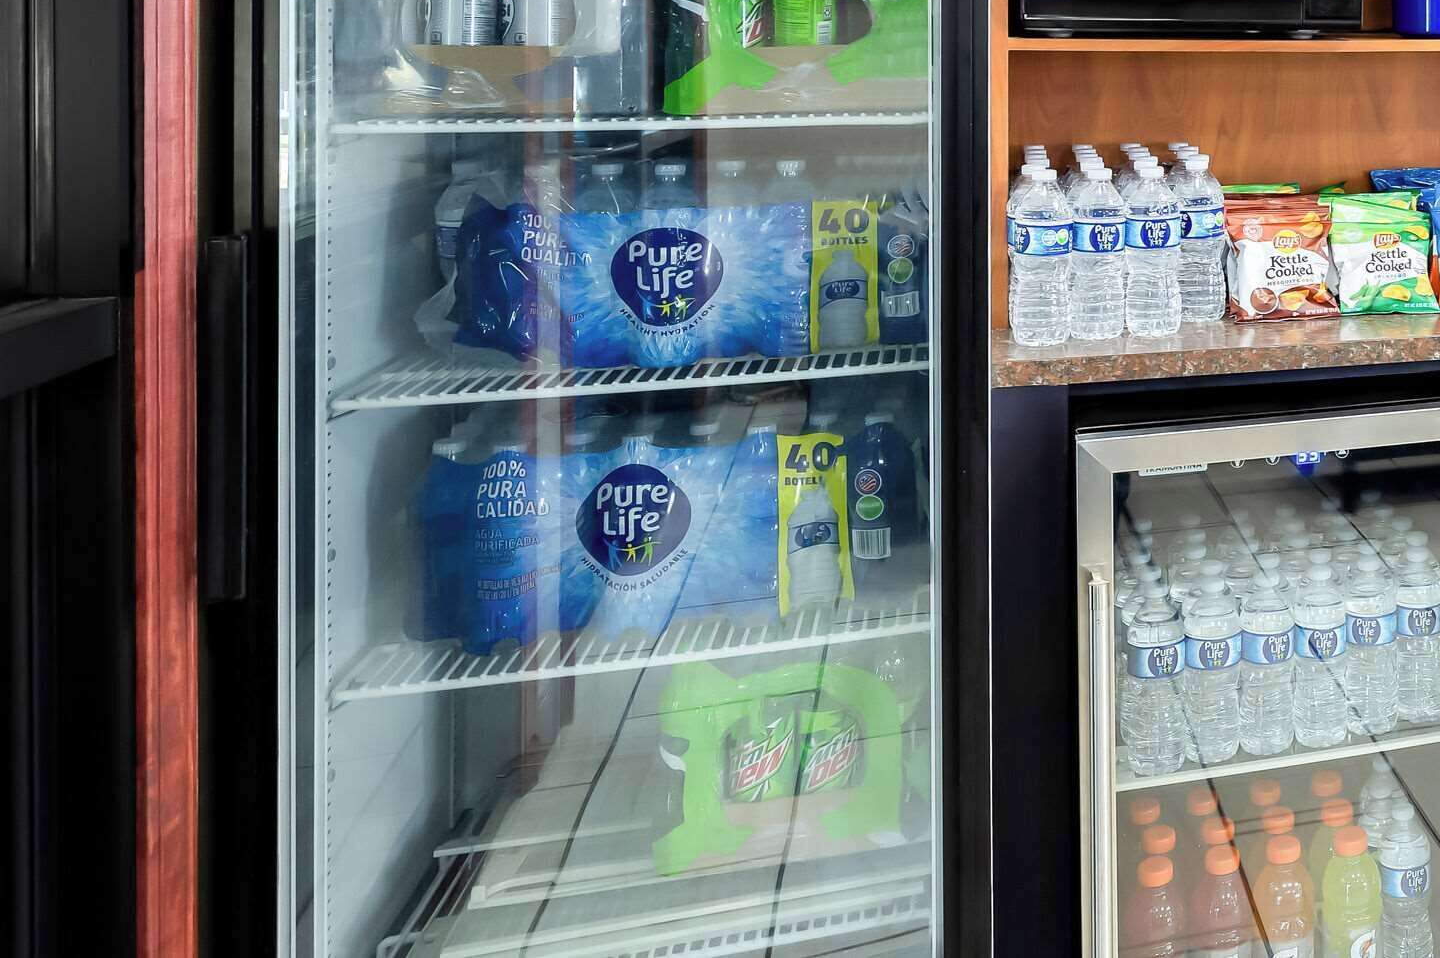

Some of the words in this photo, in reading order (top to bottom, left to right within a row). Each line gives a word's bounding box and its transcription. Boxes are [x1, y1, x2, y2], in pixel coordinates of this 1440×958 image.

[819, 208, 870, 234] 40
[1146, 221, 1167, 232] Pure
[1094, 223, 1117, 235] Pure
[1148, 230, 1165, 241] Life
[1097, 232, 1115, 243] Life
[1274, 235, 1300, 248] Lay's
[1375, 233, 1401, 247] Lay's
[628, 239, 704, 267] Pure
[1371, 248, 1407, 263] Kettle
[1270, 254, 1309, 268] Kettle
[1365, 258, 1412, 273] Cooked
[1265, 264, 1314, 280] Cooked
[636, 266, 694, 299] Life
[661, 303, 716, 337] HYDRATION
[785, 442, 837, 473] 40
[483, 460, 526, 481] 100%
[477, 480, 527, 501] PURA
[596, 482, 670, 510] Pure
[476, 500, 550, 520] CALIDAD
[603, 507, 661, 542] Life
[475, 536, 539, 551] PURIFICADA
[580, 556, 637, 593] HIDRATACIÓN
[639, 549, 689, 590] SALUDABLE
[1412, 608, 1433, 621] Pure
[1356, 619, 1377, 631] Pure
[1414, 618, 1431, 630] Life
[1313, 630, 1335, 642] Pure
[1358, 628, 1375, 640] Life
[1204, 641, 1226, 653] Pure
[1268, 636, 1289, 649] Pure
[1316, 639, 1332, 651] Life
[1153, 646, 1176, 658] Pure
[1206, 650, 1224, 662] Life
[1270, 645, 1287, 657] Life
[1156, 655, 1174, 668] Life
[1405, 869, 1425, 882] Pure
[1408, 877, 1423, 888] Life
